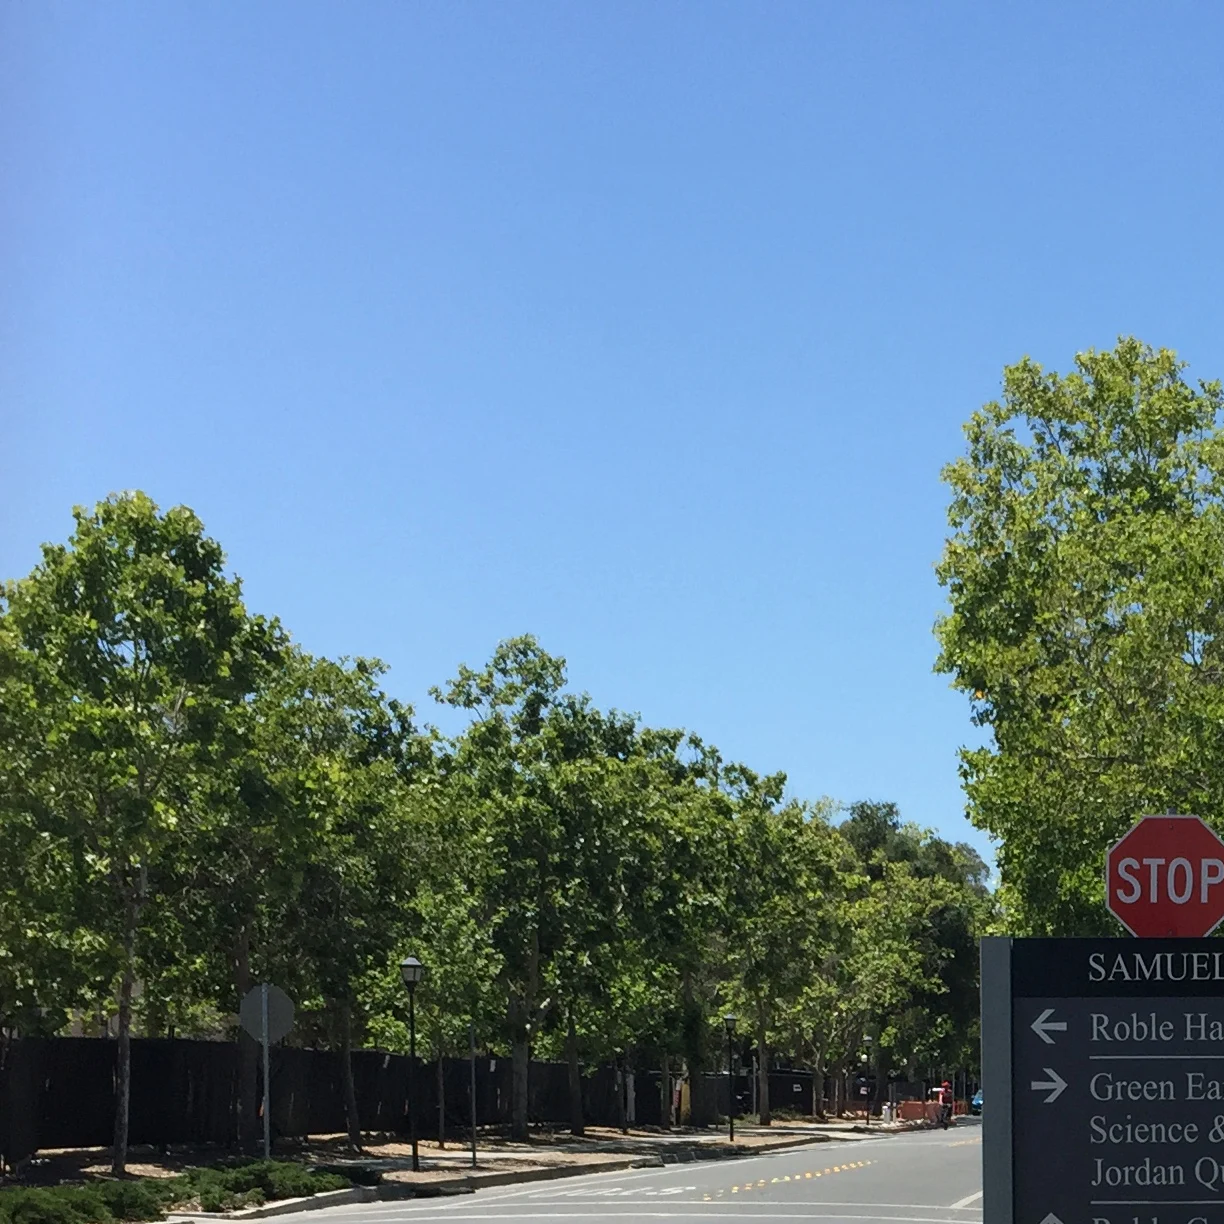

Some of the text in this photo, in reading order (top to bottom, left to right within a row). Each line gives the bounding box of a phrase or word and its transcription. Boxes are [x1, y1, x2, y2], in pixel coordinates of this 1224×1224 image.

[1090, 1013, 1174, 1042] Roble
[1090, 1073, 1176, 1101] Green
[1090, 1115, 1199, 1144] Science
[1091, 1158, 1186, 1187] Jordan
